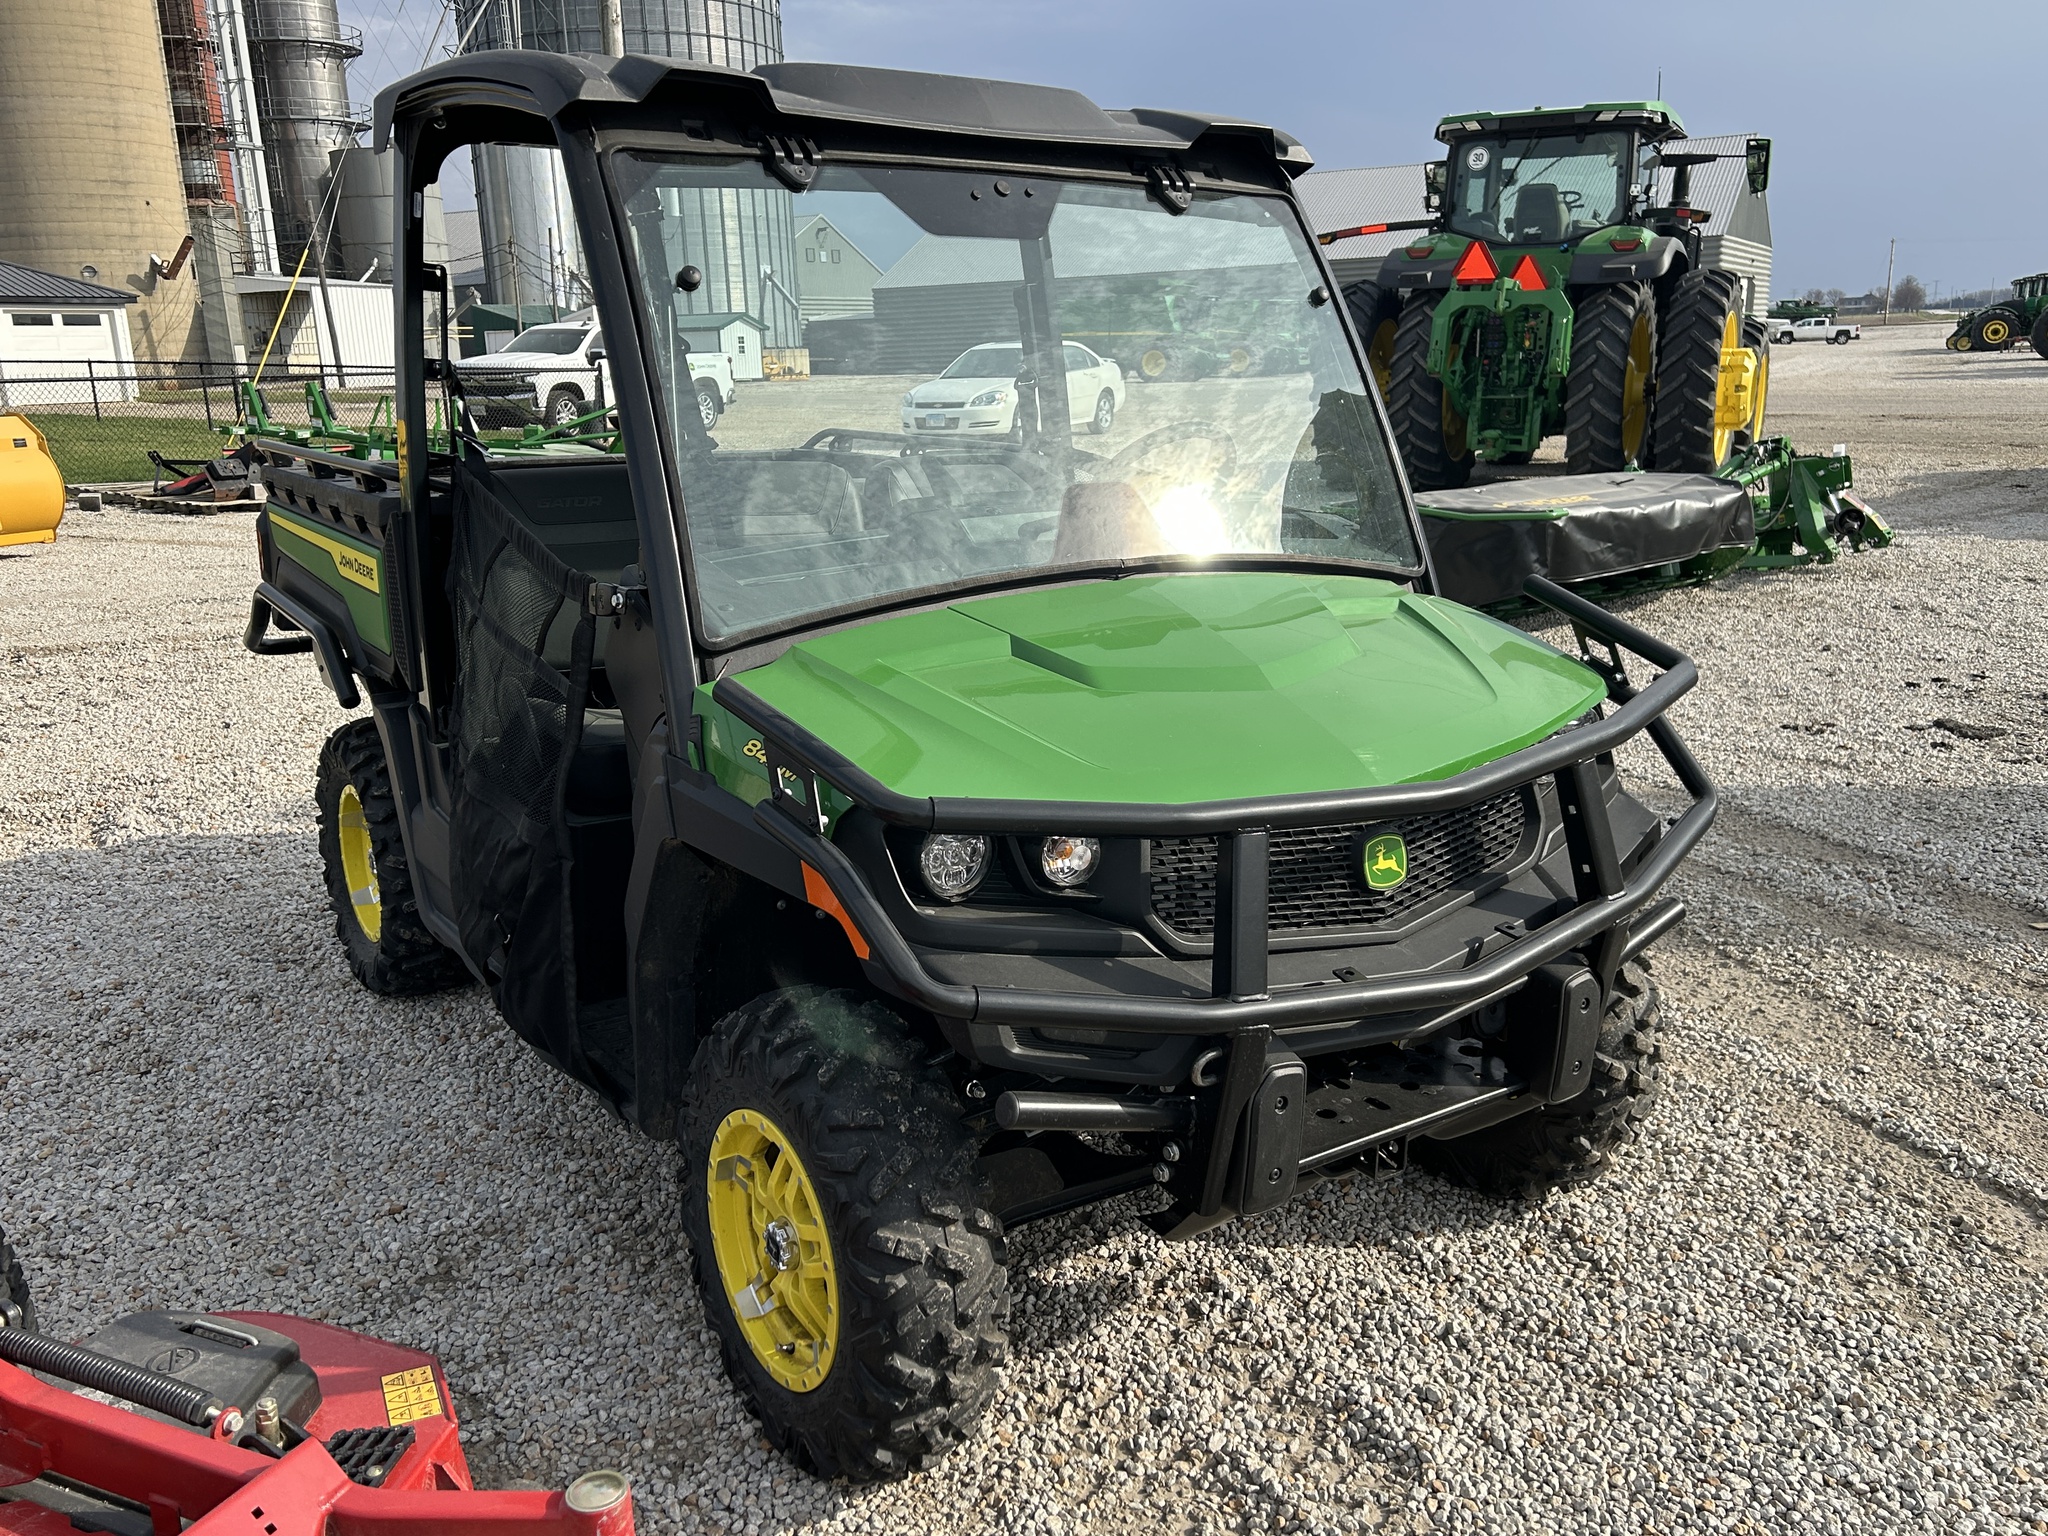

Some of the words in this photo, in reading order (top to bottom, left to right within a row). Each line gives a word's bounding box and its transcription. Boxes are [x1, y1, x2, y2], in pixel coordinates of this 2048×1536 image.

[1472, 152, 1484, 163] 30
[536, 494, 603, 509] GATOR
[339, 551, 355, 572] JOHN
[354, 557, 374, 581] DEERE
